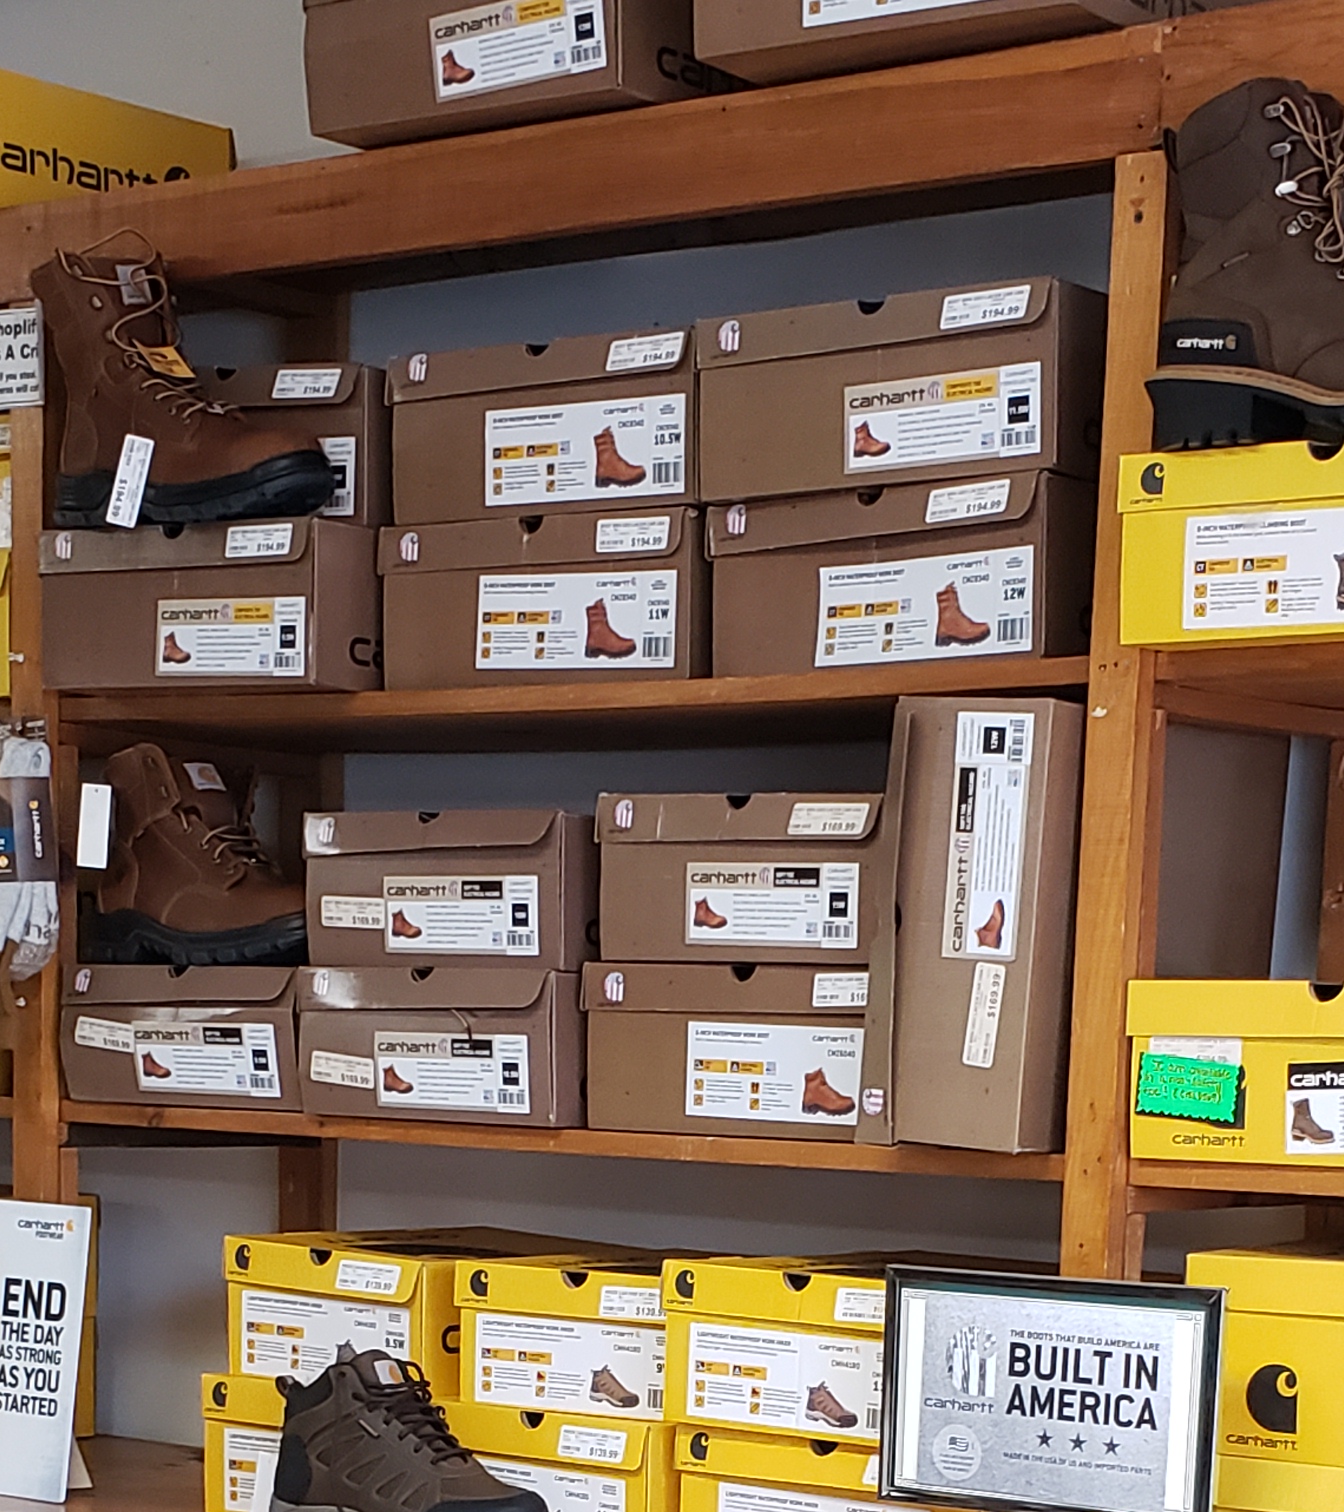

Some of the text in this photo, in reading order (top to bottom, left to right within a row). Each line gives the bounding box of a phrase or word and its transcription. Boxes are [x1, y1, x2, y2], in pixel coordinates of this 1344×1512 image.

[434, 13, 502, 40] carhartt
[5, 347, 15, 361] A
[20, 345, 39, 360] Cri
[849, 389, 925, 410] carhartt
[1002, 587, 1026, 601] 12W
[161, 607, 219, 622] carhartt
[690, 868, 755, 886] carhartt
[387, 881, 446, 898] carhartt
[1172, 1134, 1244, 1147] carhartt
[17, 1219, 64, 1231] carhartt
[1, 1277, 67, 1322] END
[1, 1321, 64, 1346] THE DAY
[1010, 1329, 1160, 1351] THE BOOTS THAT BUILD AMERICA ARE
[14, 1346, 62, 1365] STRONG
[1008, 1342, 1159, 1391] BUILT IN
[24, 1368, 61, 1393] YOU
[924, 1397, 994, 1414] carhartt
[1005, 1384, 1157, 1431] AMERICA
